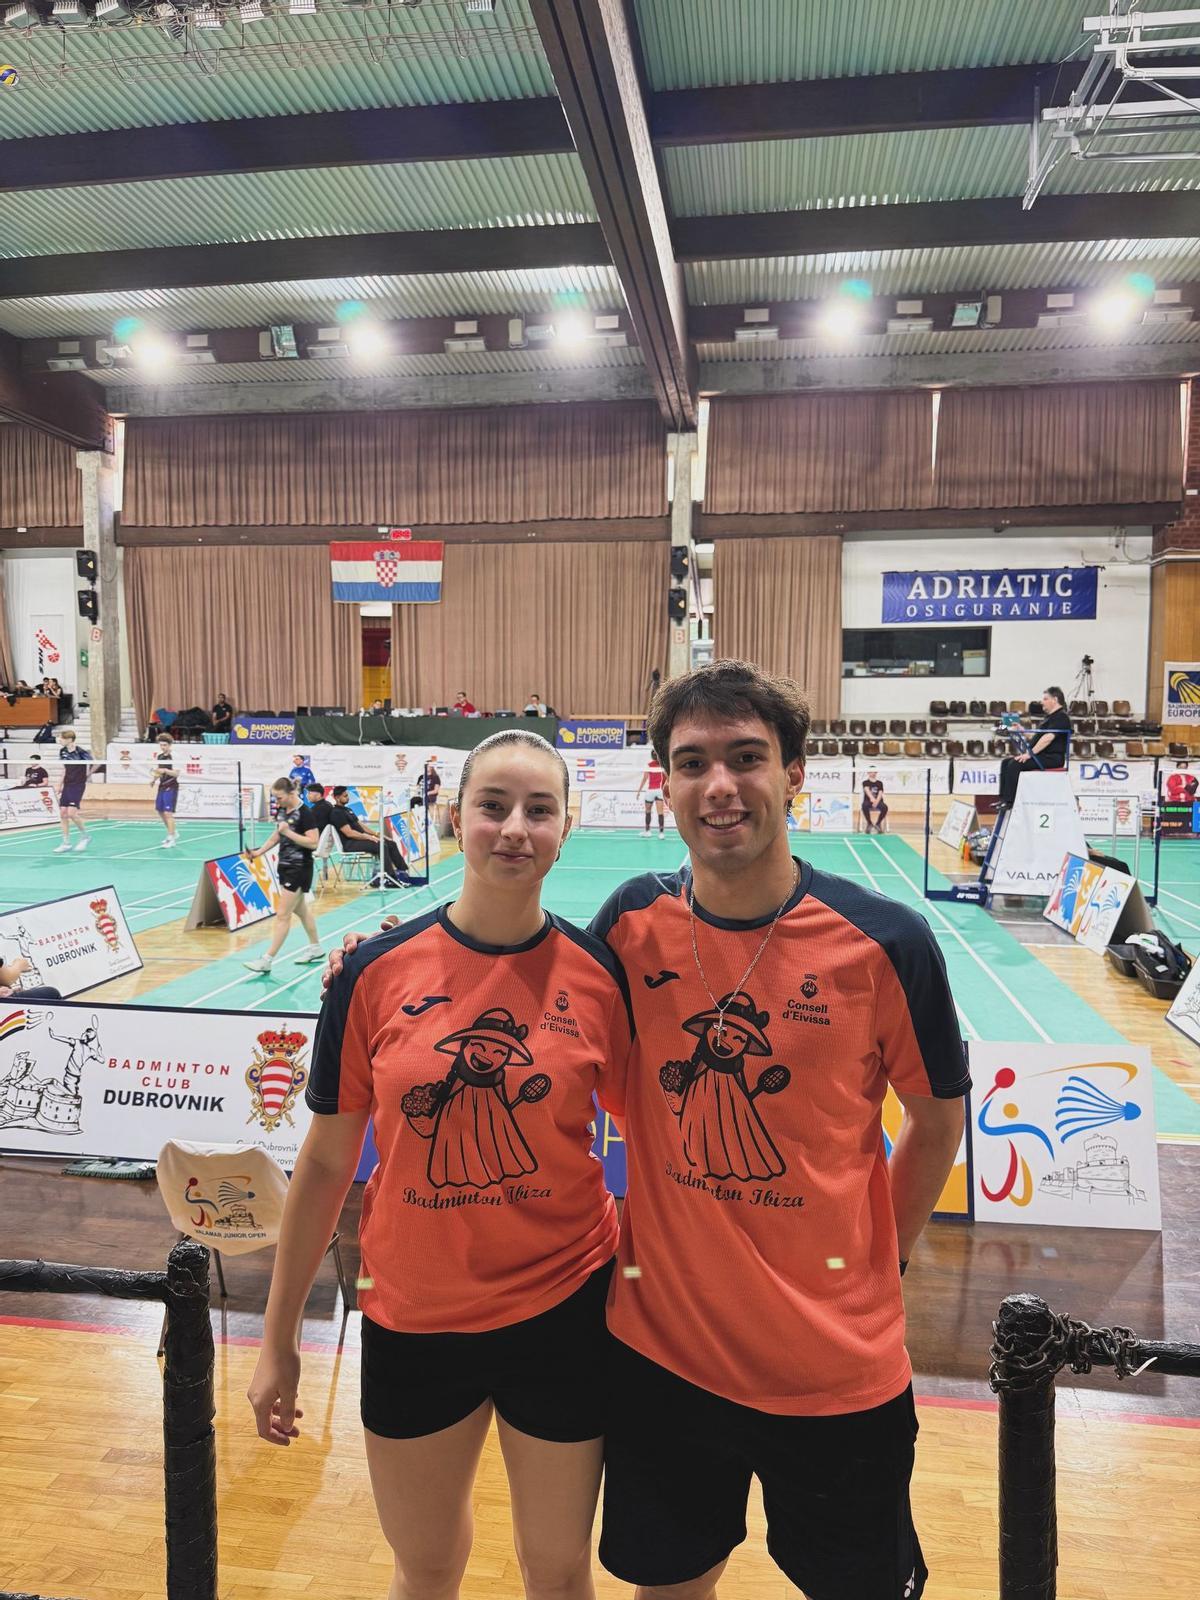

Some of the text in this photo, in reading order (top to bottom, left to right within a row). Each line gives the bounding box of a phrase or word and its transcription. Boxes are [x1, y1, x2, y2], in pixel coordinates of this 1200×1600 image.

[907, 574, 1073, 600] ADRIATIC
[906, 602, 1072, 617] OSIGURANJE
[250, 731, 293, 740] EUROPE
[577, 735, 621, 744] EUROPE
[811, 771, 840, 781] MAR
[960, 770, 1000, 784] Allia
[1080, 762, 1129, 780] DAS
[1039, 813, 1050, 828] 2
[1006, 871, 1059, 881] VALAM
[37, 925, 90, 946] BADMINTON
[57, 939, 80, 951] CLUB
[46, 943, 97, 968] DUBROVNIK
[787, 999, 828, 1014] Consell
[543, 1012, 578, 1027] Consell
[782, 1010, 831, 1026] d'Eivissa
[540, 1022, 580, 1038] d'Eivissa
[108, 1058, 230, 1076] BADMINTON
[142, 1076, 191, 1090] CLUB
[103, 1089, 225, 1113] DUBROVNIK
[402, 1184, 553, 1210] Badminton Ibiza
[750, 1189, 805, 1208] Ibiza
